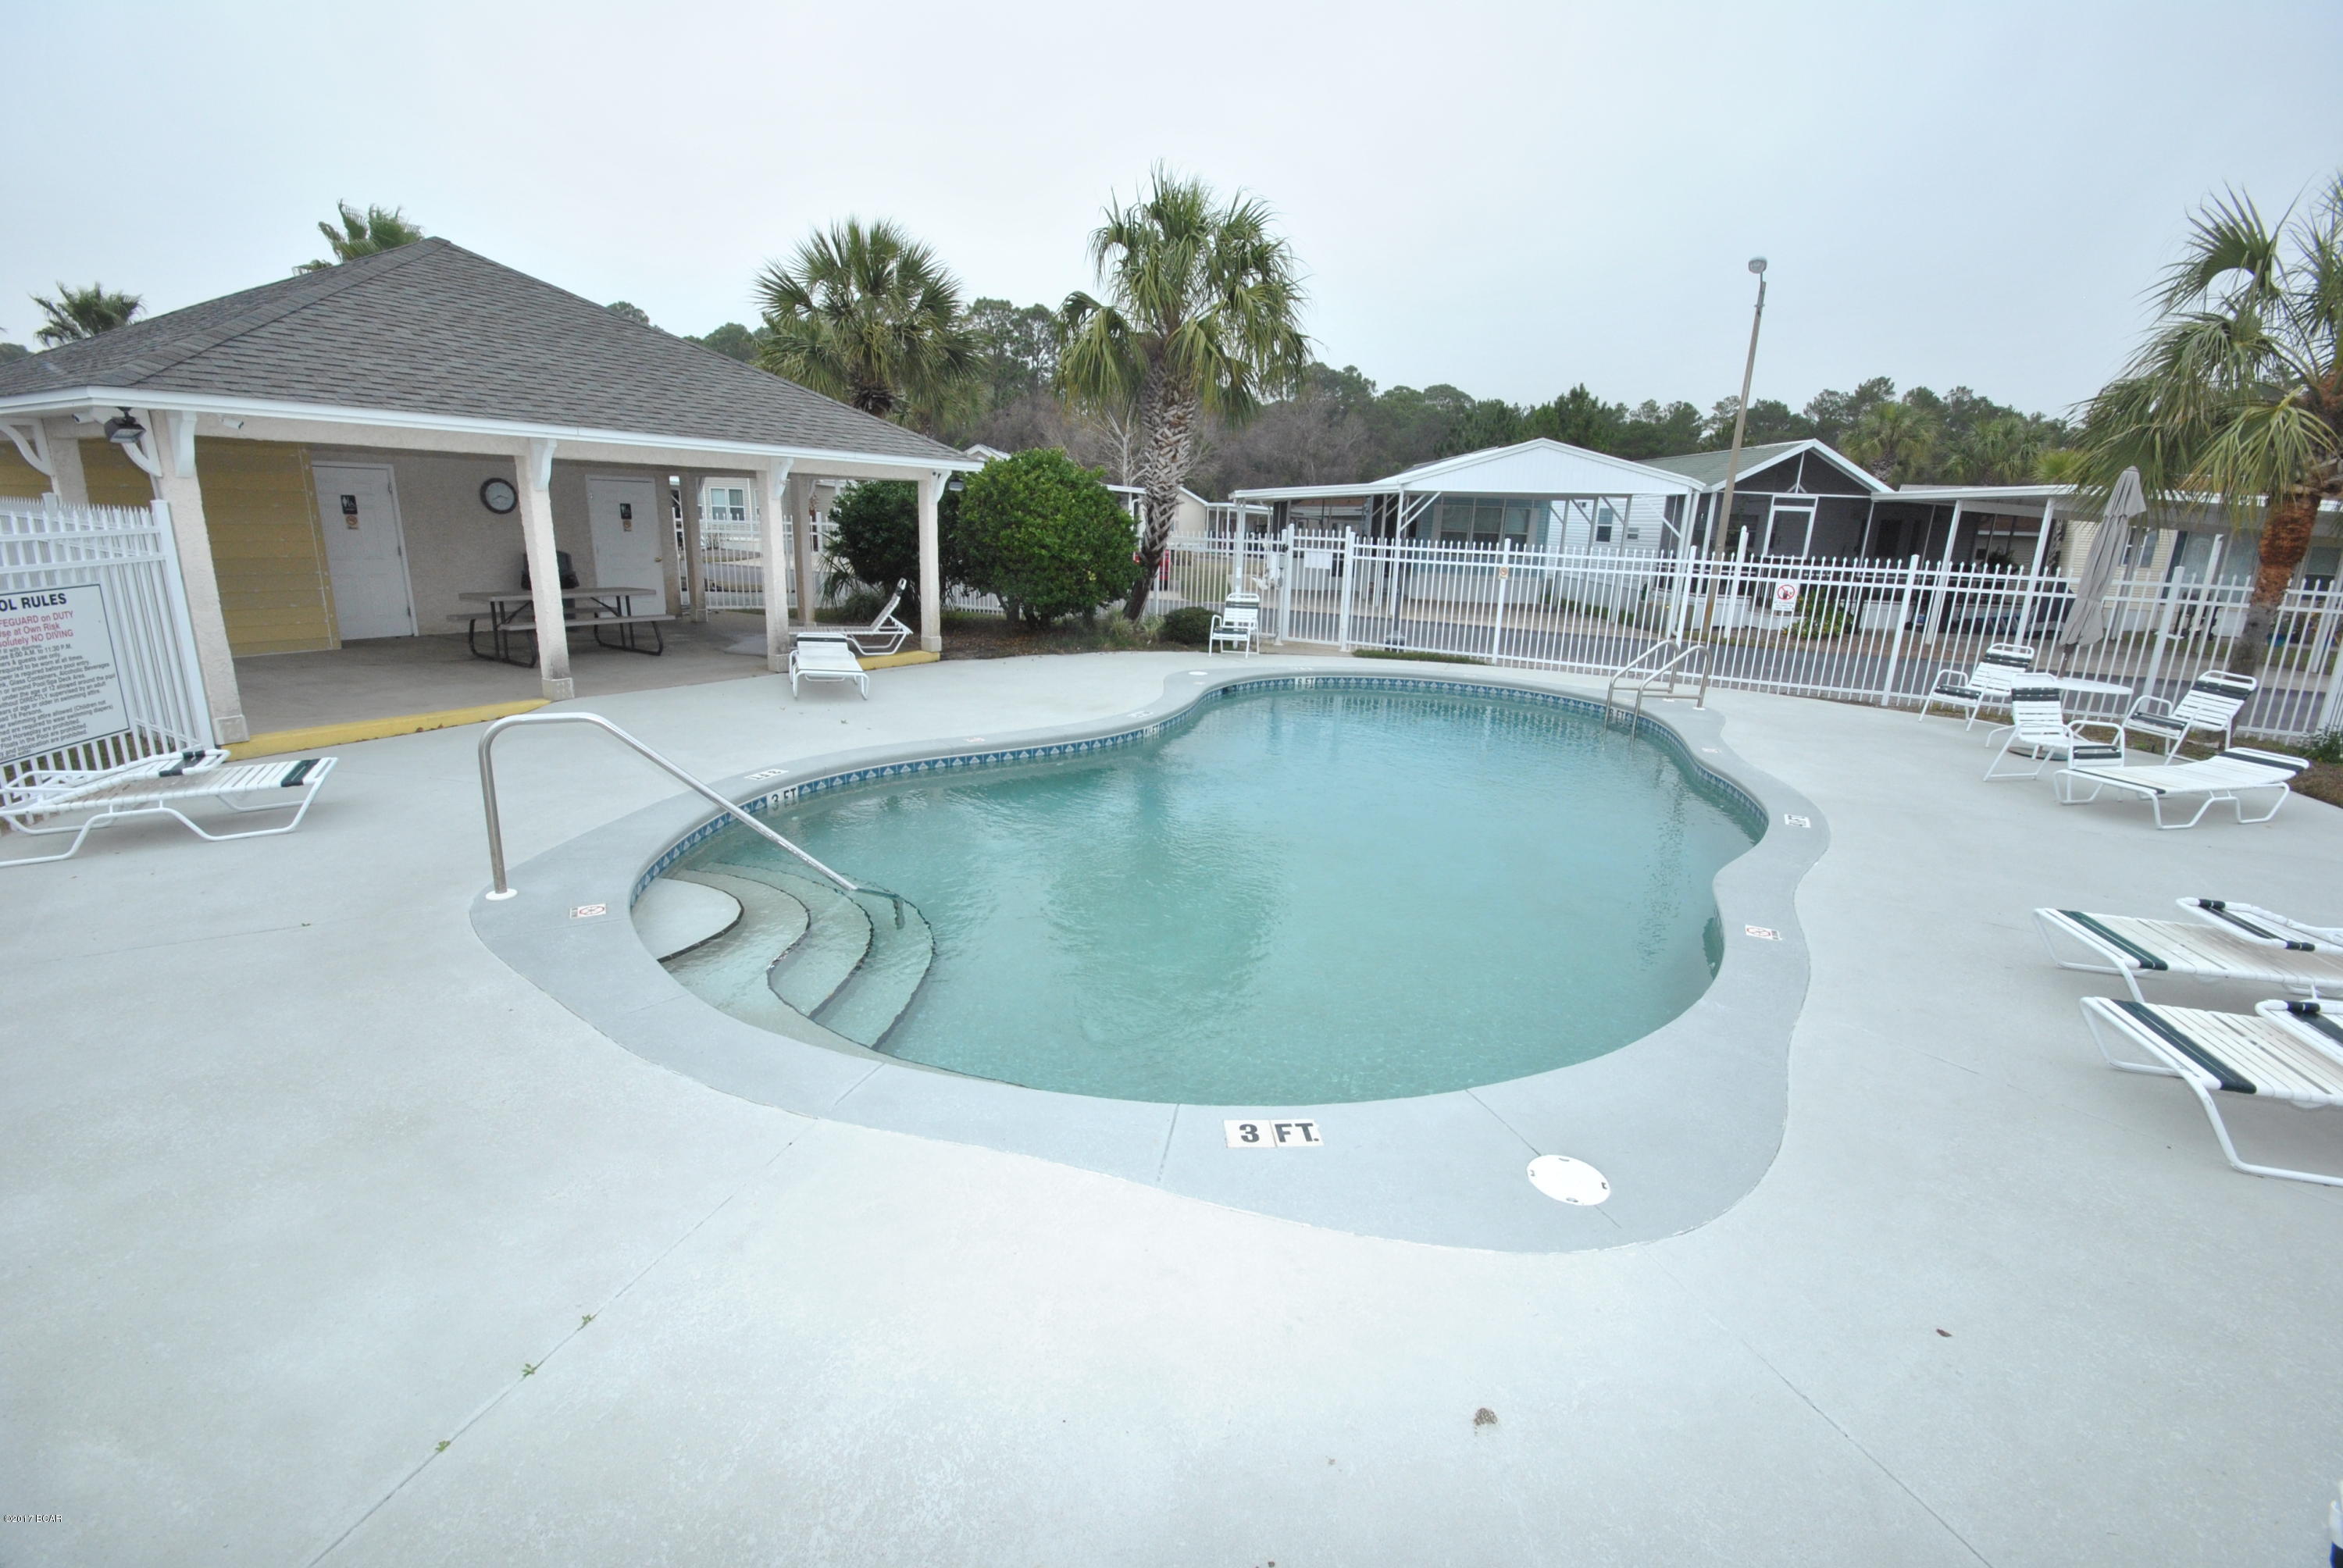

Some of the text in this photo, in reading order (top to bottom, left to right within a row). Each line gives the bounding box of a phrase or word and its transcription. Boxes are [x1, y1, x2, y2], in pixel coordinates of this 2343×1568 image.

[20, 593, 67, 608] RULES
[52, 611, 74, 620] DUTY
[23, 625, 41, 634] Own
[43, 622, 60, 631] Risk
[31, 633, 44, 643] NO
[45, 629, 73, 640] DIVING
[1239, 1122, 1320, 1143] 3 FT.
